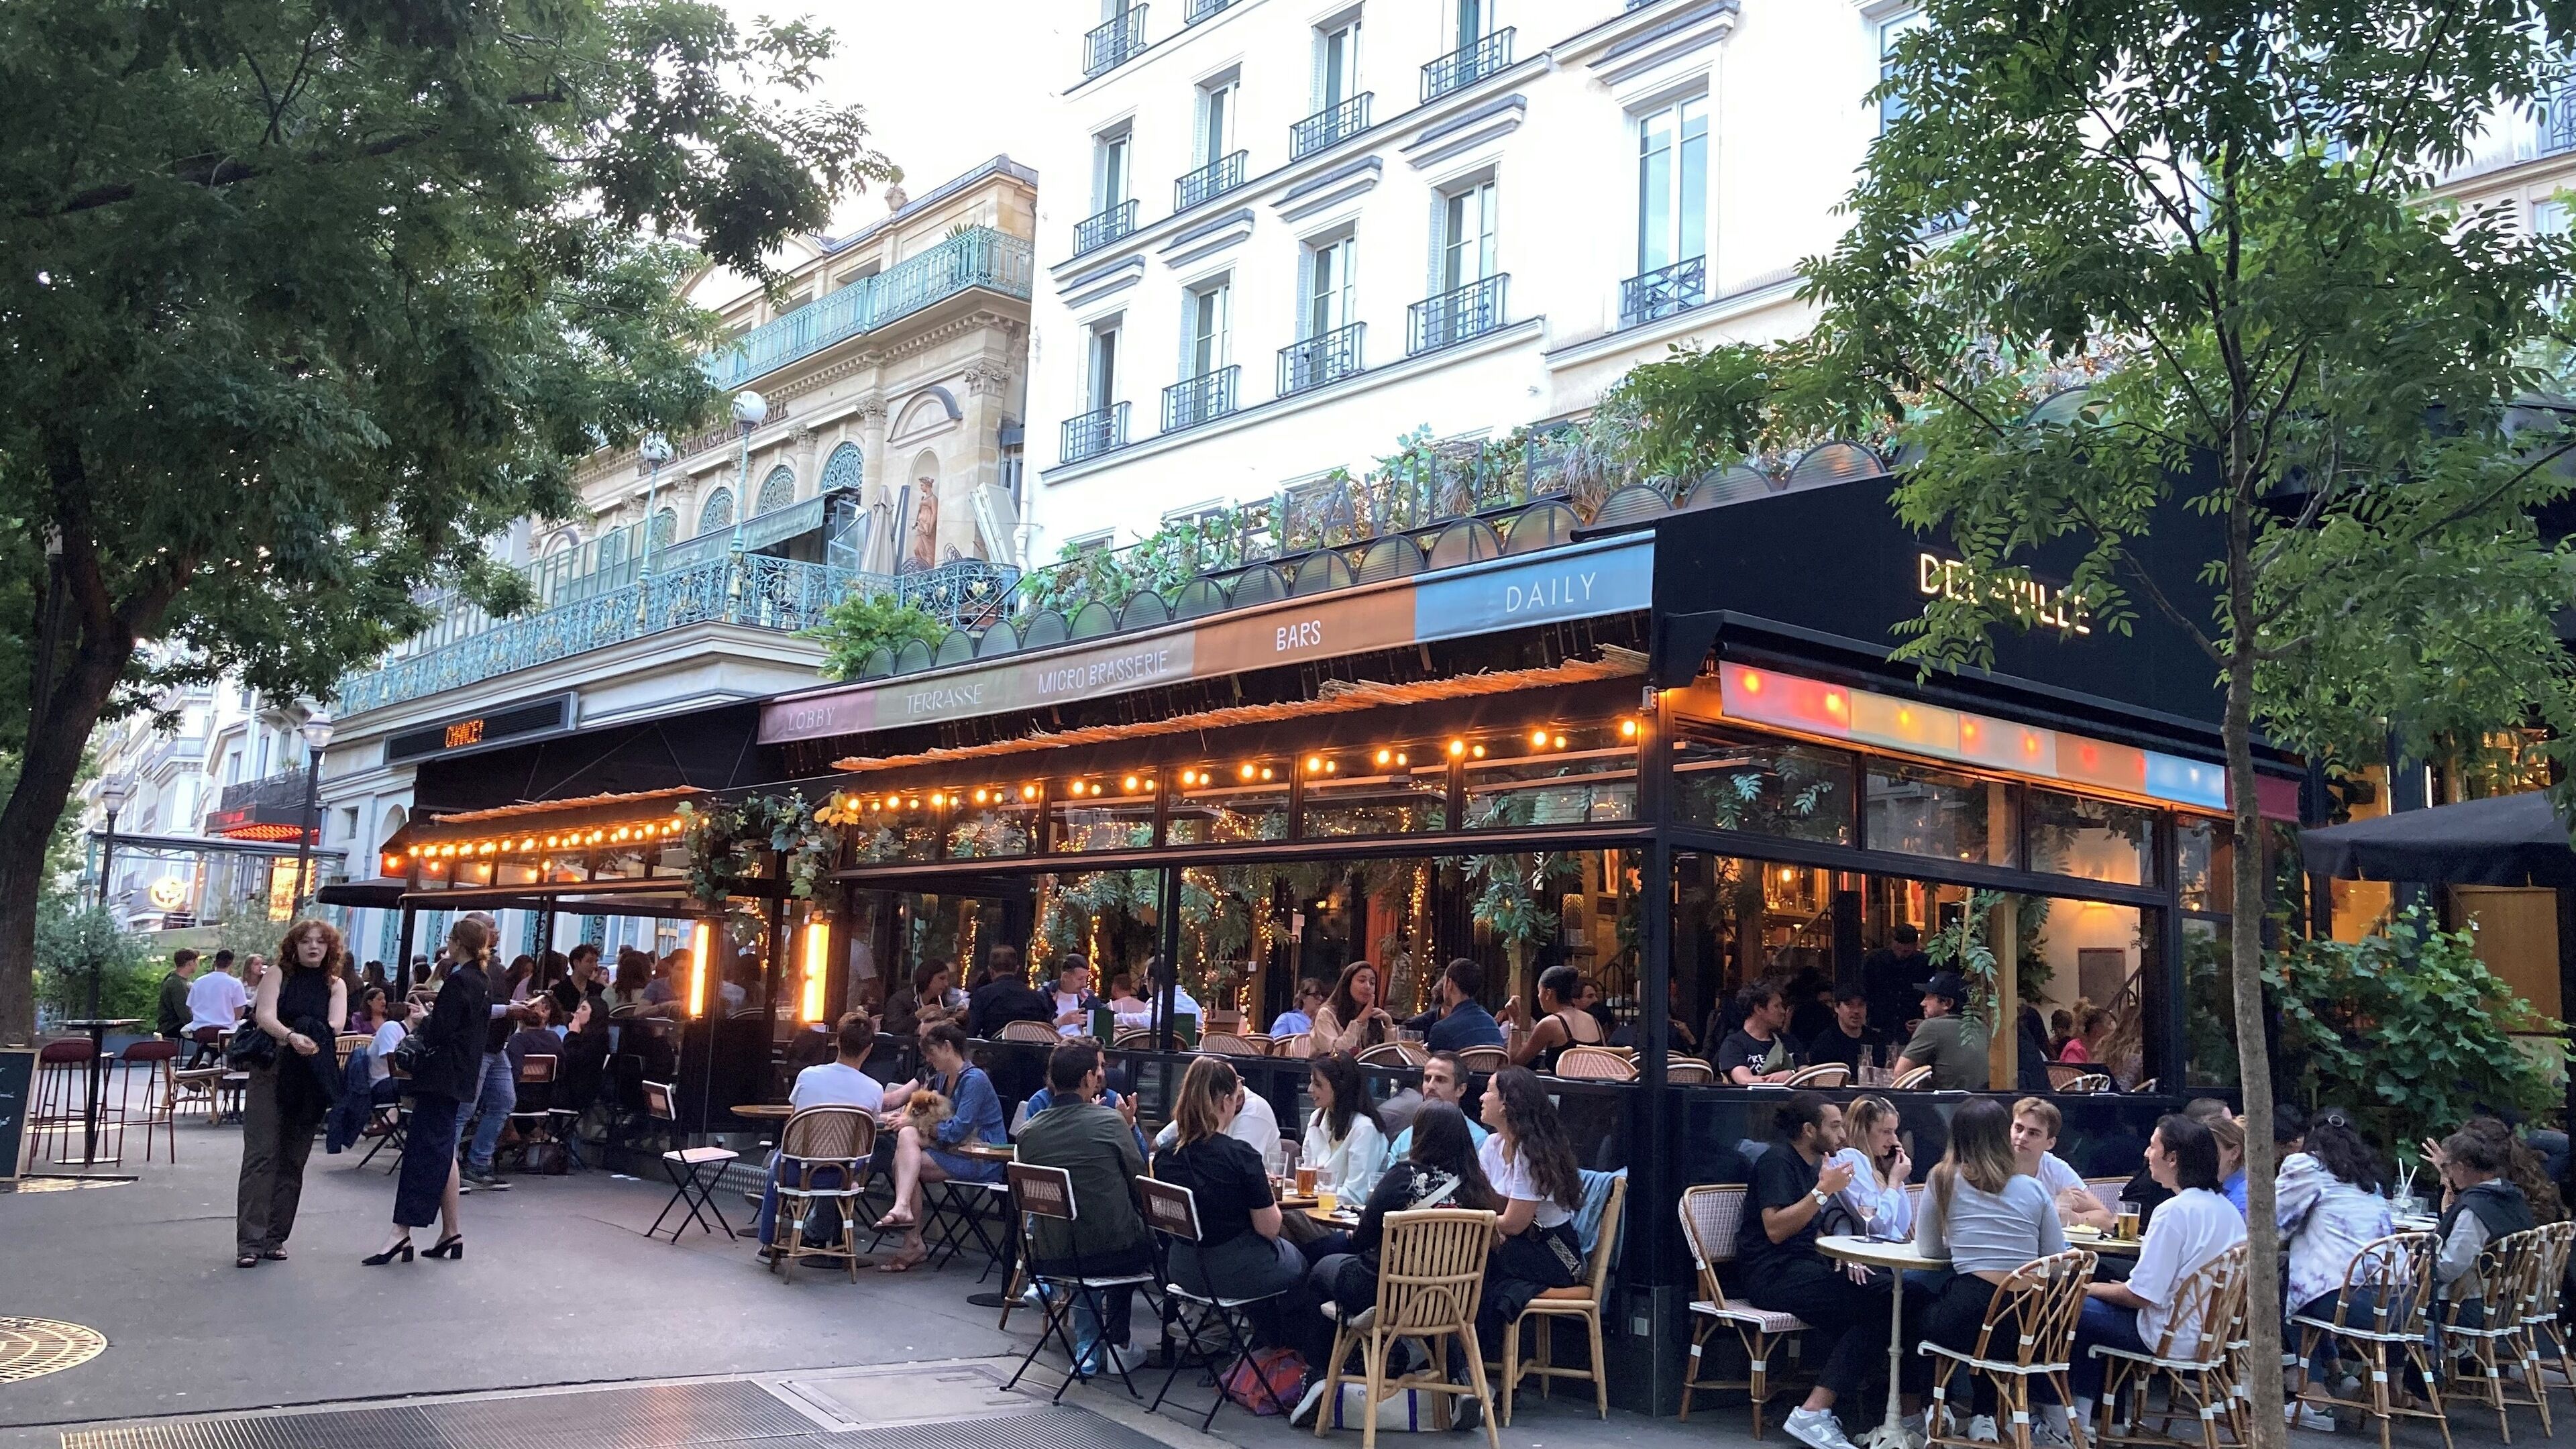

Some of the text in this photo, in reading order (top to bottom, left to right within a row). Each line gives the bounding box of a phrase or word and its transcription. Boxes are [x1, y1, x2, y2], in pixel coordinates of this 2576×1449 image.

[1197, 420, 1568, 572] DELAVILLE
[1506, 572, 1597, 613] DAILY
[1276, 619, 1322, 652] BARS
[1038, 649, 1169, 695] MICRO BRASSERIE
[906, 683, 984, 714] TERRASSE
[788, 706, 836, 732] LOBBY
